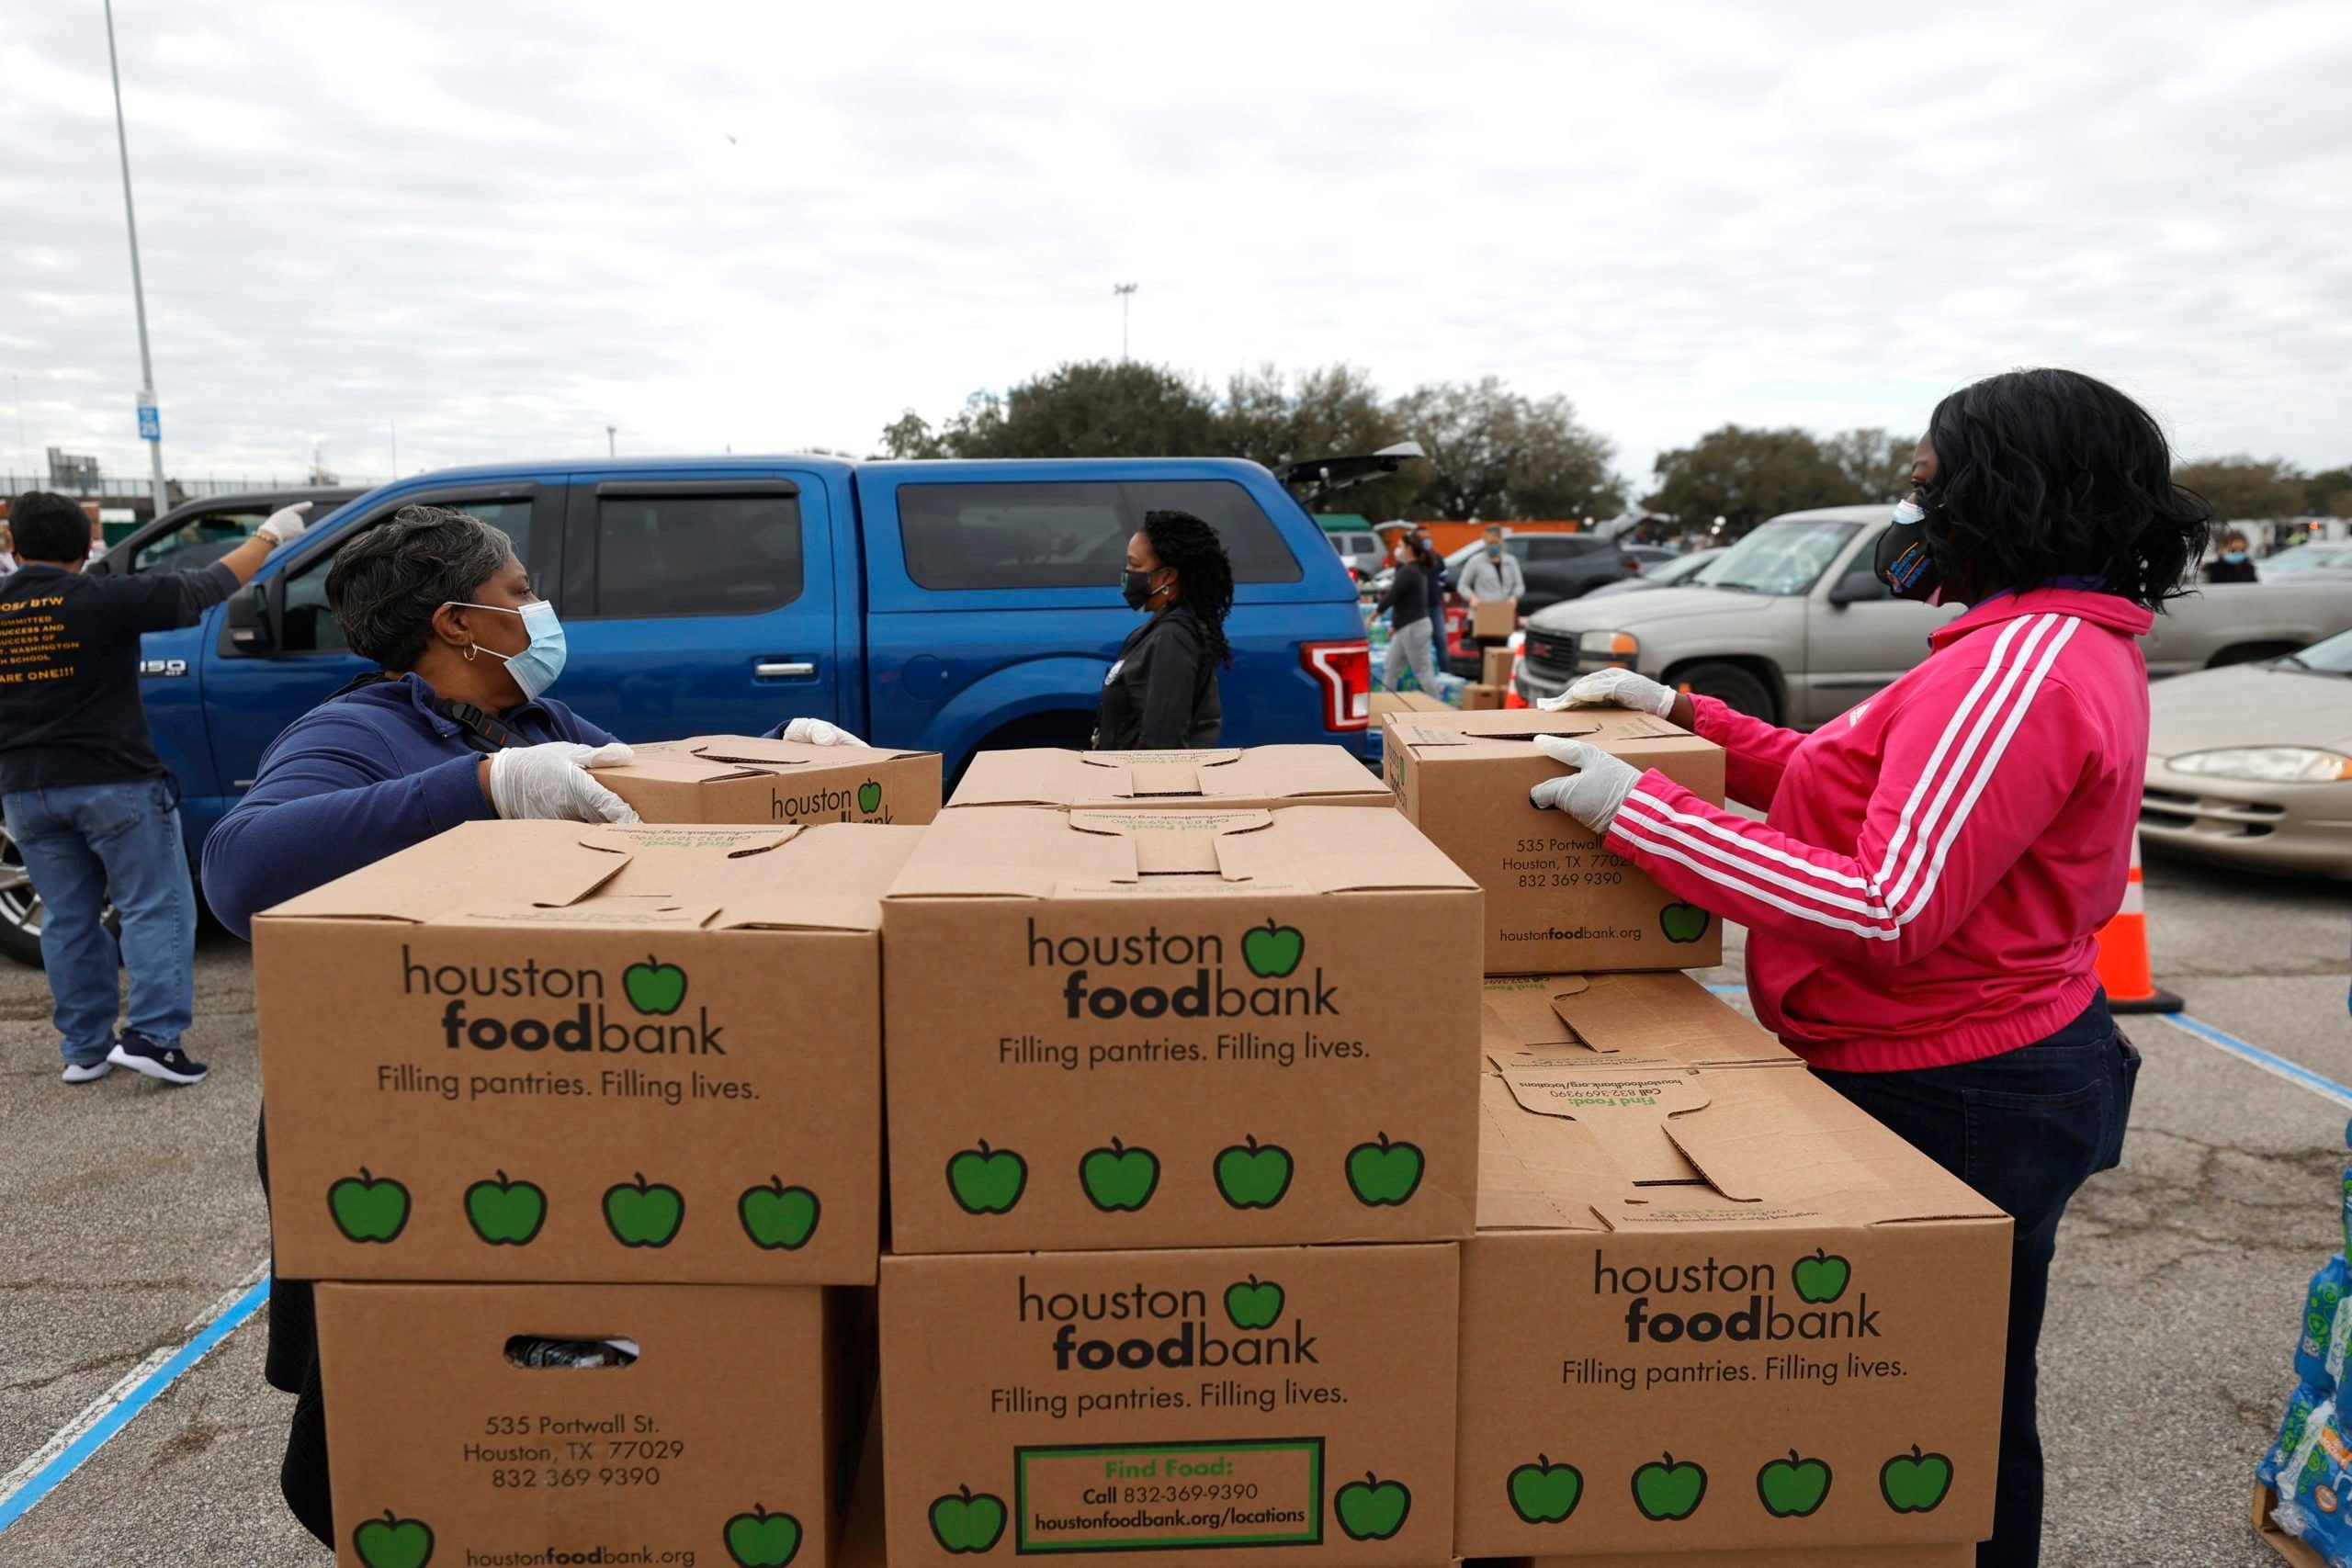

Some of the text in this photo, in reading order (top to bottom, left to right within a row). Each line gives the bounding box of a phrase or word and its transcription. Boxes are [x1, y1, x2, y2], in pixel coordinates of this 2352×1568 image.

[30, 596, 63, 608] BTW
[0, 615, 52, 626] OMMITTED
[42, 625, 64, 633] AND
[9, 641, 80, 655] WASHINGTON
[10, 655, 51, 664] SCHOOL
[28, 667, 74, 682] ONE!!!
[772, 787, 852, 820] houston
[1516, 835, 1602, 852] 535 Portwall
[1502, 854, 1635, 871] Houston, TX 7702
[1519, 872, 1623, 888] 832 369 9390
[1027, 917, 1223, 966] houston
[1499, 926, 1642, 942] houstonfoodbank.org
[401, 944, 604, 998] houston
[1063, 967, 1340, 1019] foodbank
[441, 999, 727, 1055] foodbank
[999, 1032, 1370, 1070] Filling pantries. Filling lives.
[378, 1064, 761, 1106] Filling pantries. Filling lives.
[1519, 1080, 1683, 1089] houstonfoodbank.org/locations
[1550, 1089, 1635, 1098] 832-369-9390
[1567, 1097, 1657, 1108] Find Food:
[1595, 1248, 1776, 1294] houston
[1019, 1275, 1206, 1322] houston
[1624, 1292, 1882, 1343] foodbank
[1053, 1318, 1320, 1371] foodbank
[1563, 1352, 1907, 1390] Filling pantries. Filling lives.
[990, 1380, 1349, 1418] Filling pantries. Filling lives.
[485, 1414, 661, 1436] 535 Portwall St.
[463, 1440, 684, 1463] Houston, TX 77029
[492, 1467, 661, 1488] 832 369 9390
[1105, 1456, 1233, 1480] Find Food:
[1082, 1483, 1258, 1506] Call 832-369-9390
[1035, 1506, 1306, 1531] houstonfoodbank.org/locations
[466, 1546, 695, 1568] houstonfoodbank.org
